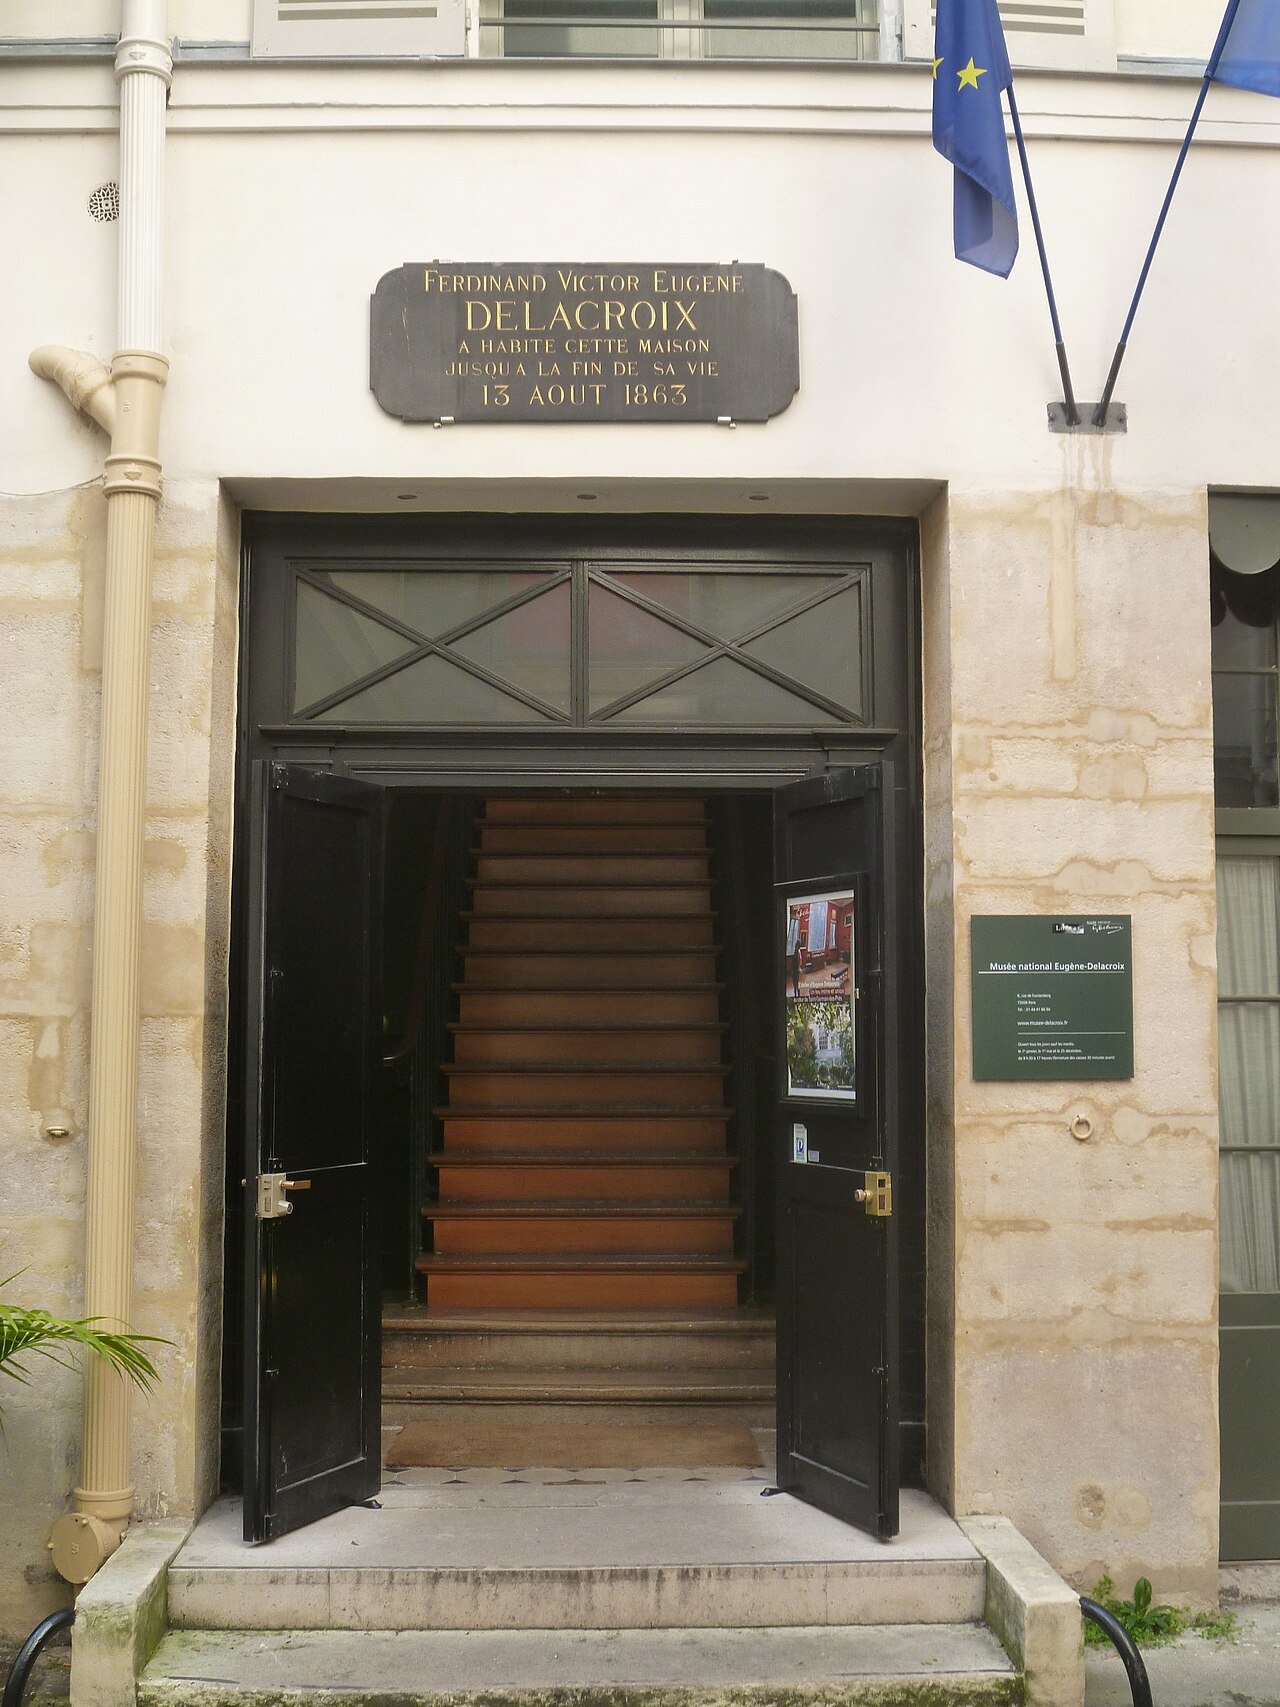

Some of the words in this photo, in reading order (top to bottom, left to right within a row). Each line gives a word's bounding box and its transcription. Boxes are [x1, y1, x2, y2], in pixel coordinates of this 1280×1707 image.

[424, 270, 546, 292] FERDINAND
[557, 269, 640, 292] VICTOR
[465, 300, 698, 332] DELACROIX
[458, 340, 469, 353] A
[480, 339, 556, 353] HABITE
[565, 338, 628, 353] CETTE
[638, 338, 710, 353] MAISON
[538, 361, 561, 376] LA
[572, 361, 602, 376] FIN
[613, 361, 638, 376] DE
[653, 361, 677, 376] SA
[687, 361, 719, 377] VIE
[482, 384, 511, 406] 13
[528, 383, 607, 406] AOUT
[623, 383, 688, 406] 1863
[989, 962, 1017, 971] Musée
[1018, 961, 1053, 971] national
[1054, 961, 1125, 972] Eugène-Delacroix
